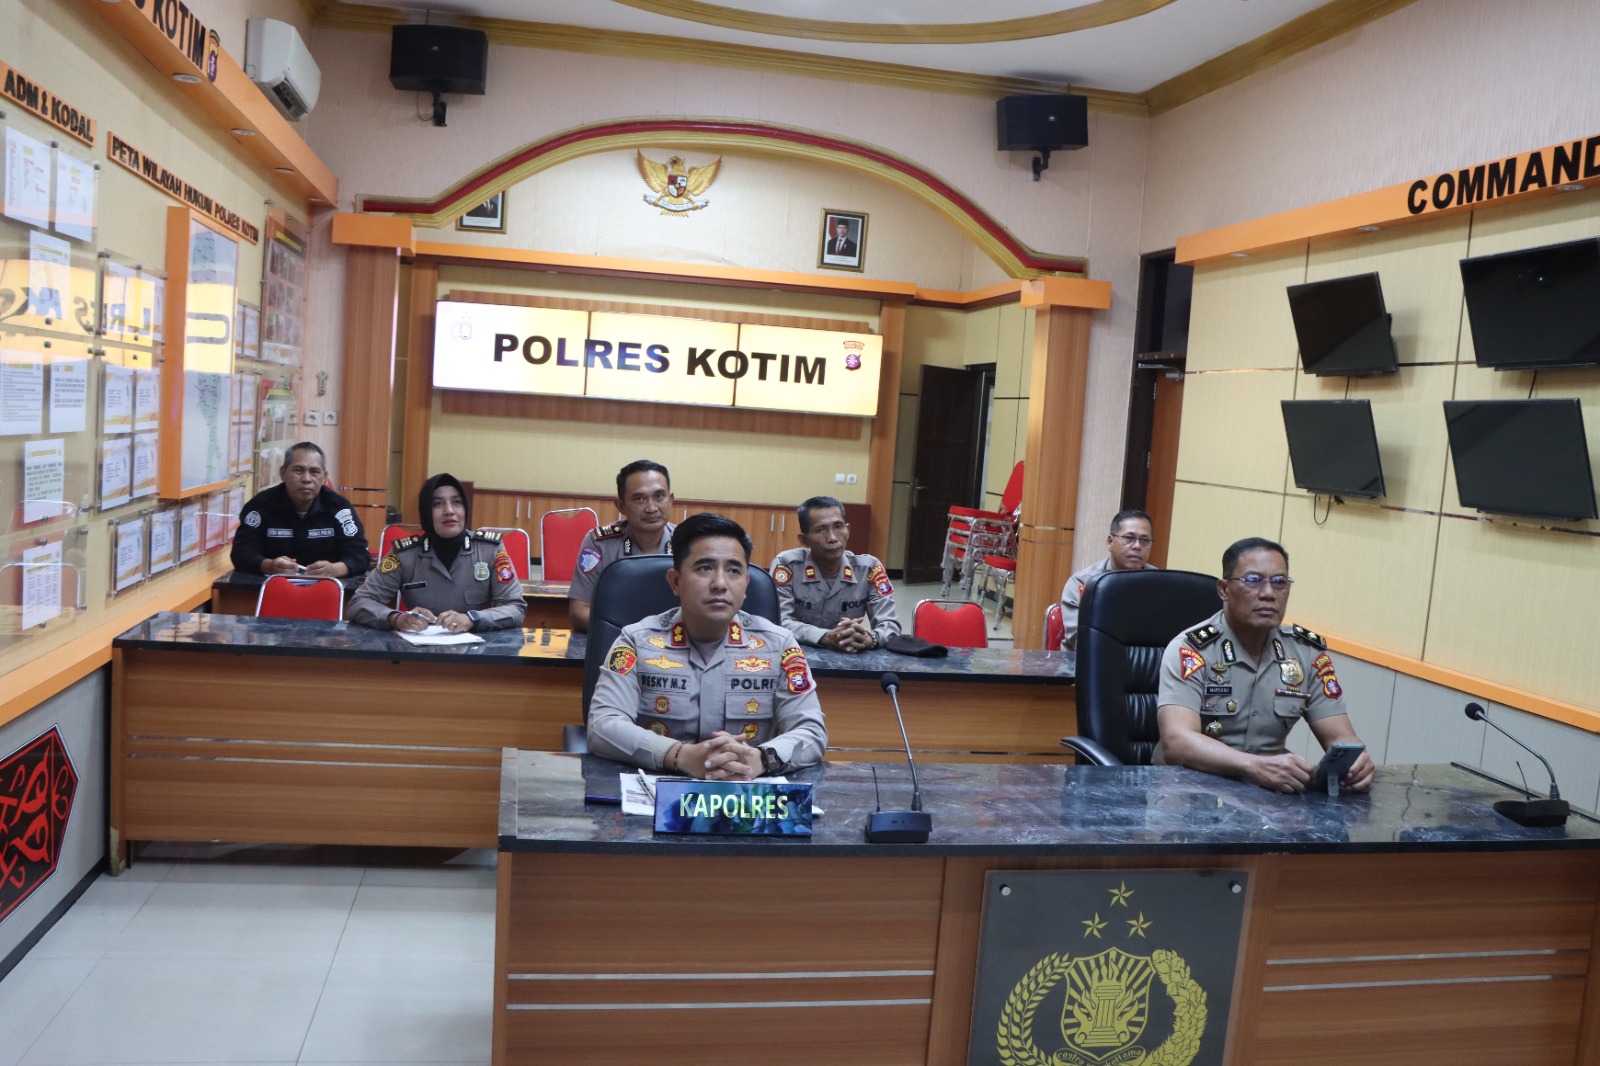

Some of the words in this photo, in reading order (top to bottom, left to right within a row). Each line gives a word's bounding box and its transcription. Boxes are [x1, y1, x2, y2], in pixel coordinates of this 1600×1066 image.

[152, 0, 206, 70] KOTIM
[4, 69, 39, 110] ADM
[41, 90, 48, 115] &
[51, 96, 94, 142] KODAL
[112, 136, 140, 171] PETA
[142, 155, 182, 198] WILAYAH
[184, 183, 213, 215] HUKUM
[215, 203, 240, 231] POLRES
[241, 219, 259, 243] KOTIM
[1407, 135, 1600, 214] COMMAND
[493, 333, 670, 373] POLRES
[686, 348, 827, 385] KOTIM
[641, 674, 668, 688] RESKY
[731, 678, 774, 690] POLRI
[679, 793, 790, 820] KAPOLRES
